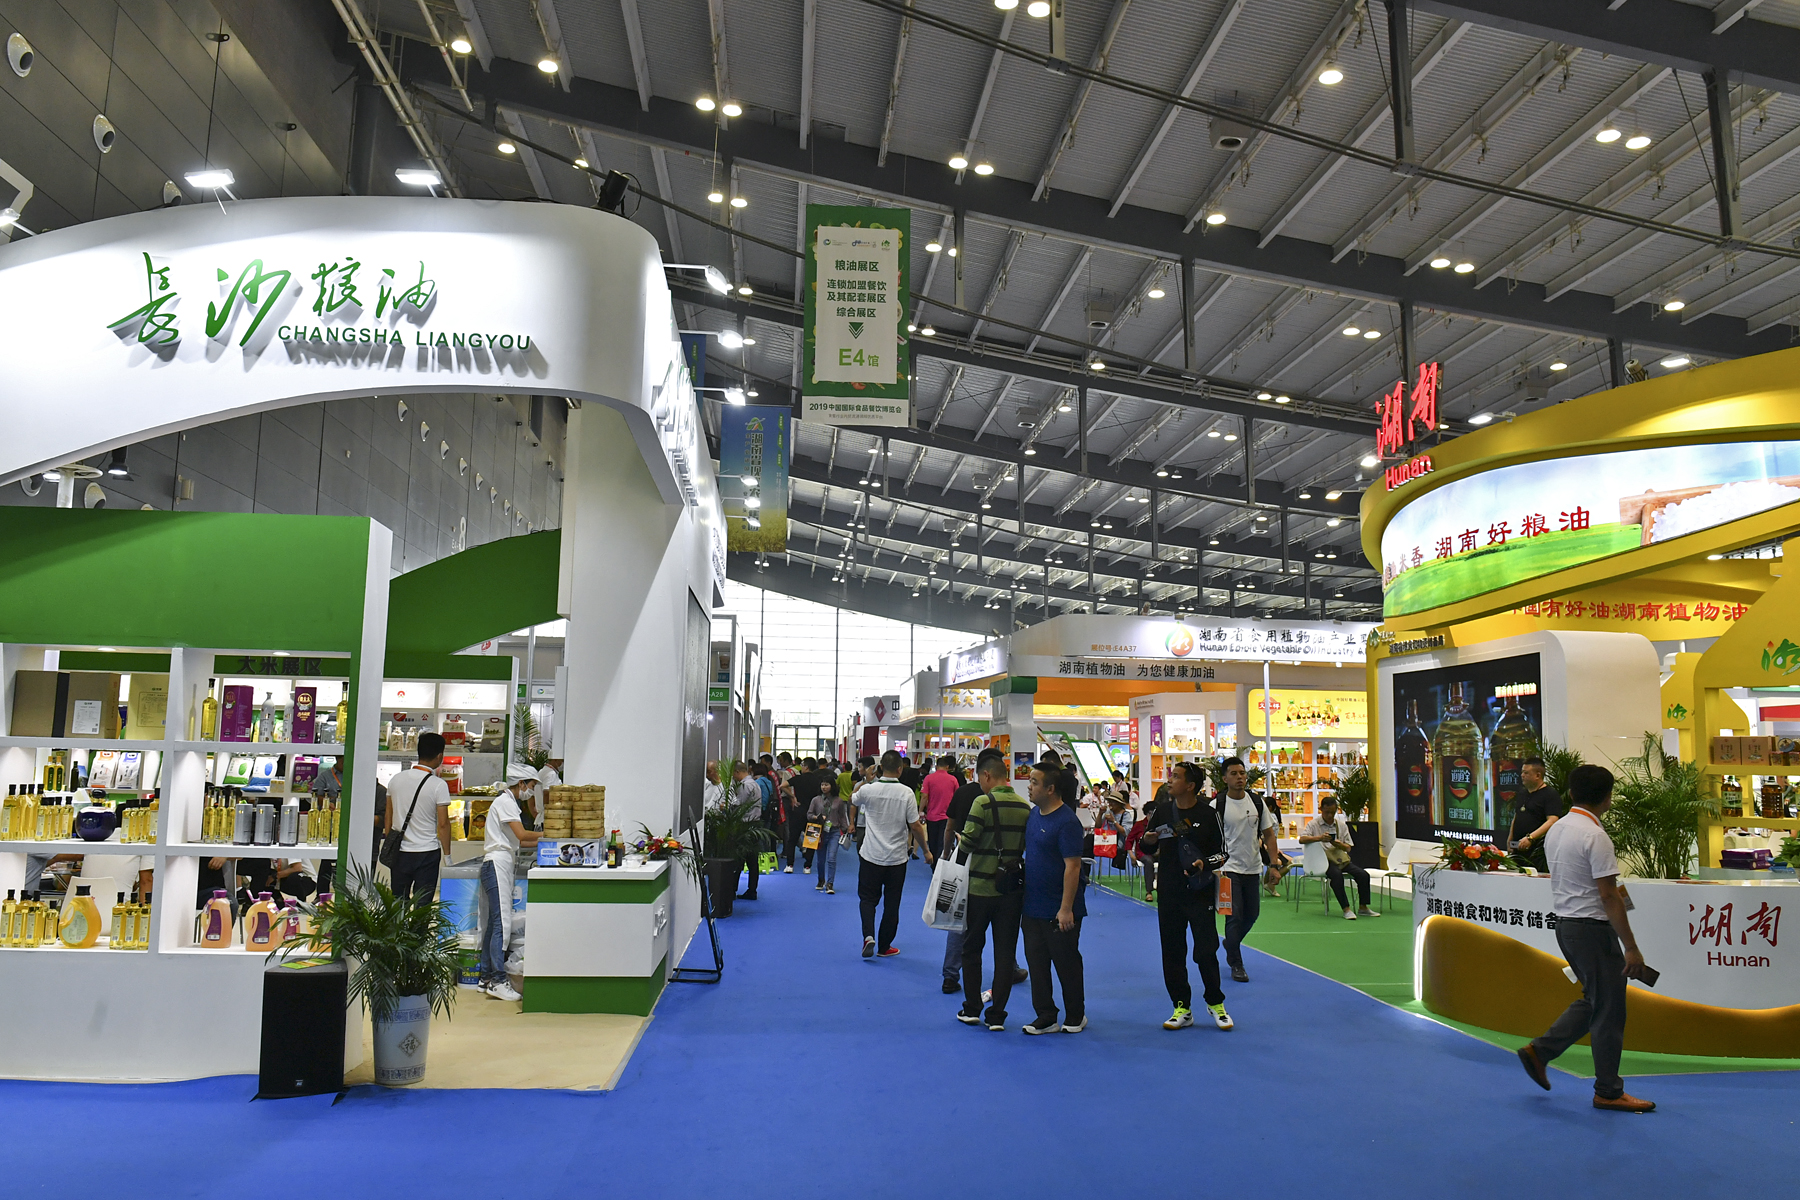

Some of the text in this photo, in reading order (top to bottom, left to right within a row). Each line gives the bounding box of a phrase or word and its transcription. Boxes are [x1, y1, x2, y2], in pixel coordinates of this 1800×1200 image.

[835, 260, 879, 272] 粮油展区
[827, 279, 886, 291] 连锁加盟餐饮
[827, 291, 886, 303] 及其配套展区
[836, 307, 876, 318] 综合展区
[278, 325, 531, 350] CHANGSHA LIANGYOU
[1375, 361, 1438, 461] 湖南
[1385, 455, 1432, 491] Hunan
[1435, 506, 1590, 560] 湖南好粮油
[1513, 598, 1749, 621] 国有好油湖南植物油
[1199, 642, 1228, 652] Hunan
[1260, 644, 1302, 655] Vegetable
[237, 655, 323, 676] 大米展区
[1059, 660, 1215, 679] 湖南植物油 为您健康加油
[1689, 902, 1781, 947] 湖南
[1707, 951, 1770, 967] Hunan
